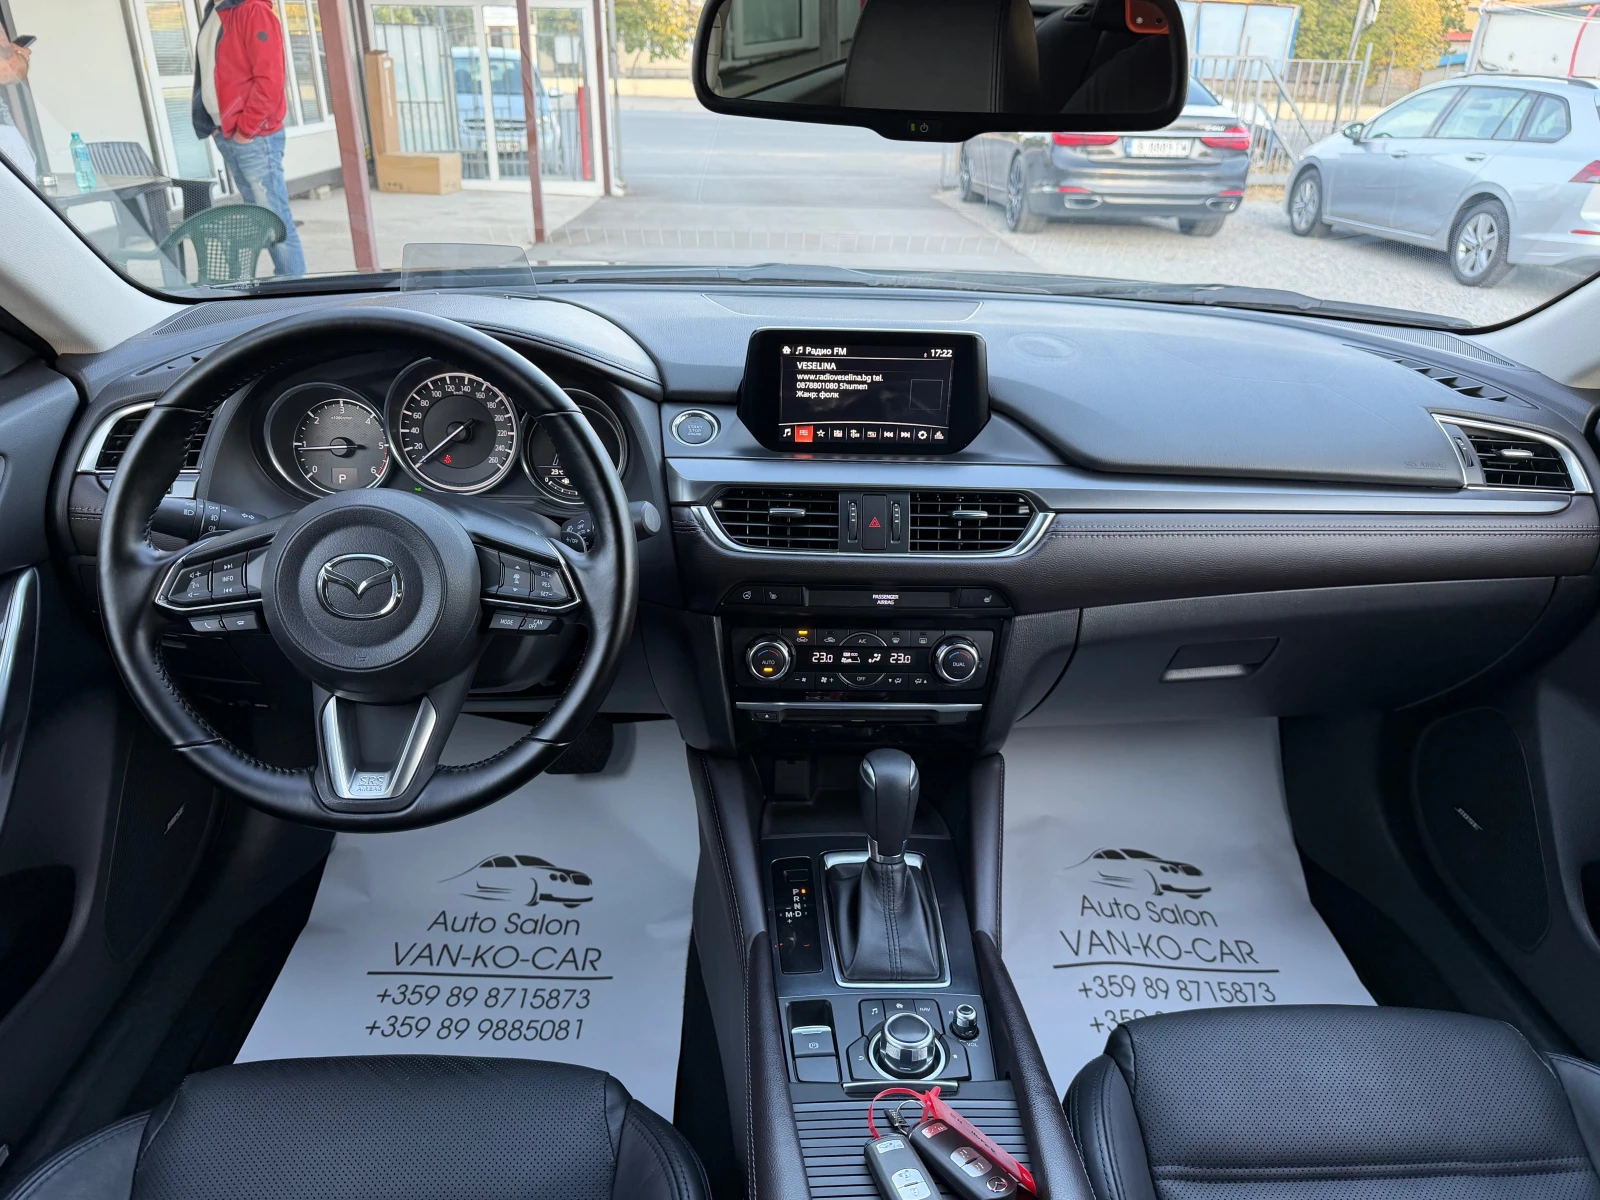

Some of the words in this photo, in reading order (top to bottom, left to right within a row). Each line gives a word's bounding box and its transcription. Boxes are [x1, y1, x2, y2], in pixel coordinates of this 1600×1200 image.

[806, 347, 832, 356] Радио
[833, 347, 847, 355] FM
[930, 349, 953, 358] 17:22
[796, 361, 837, 370] VESELINA
[796, 373, 872, 383] www.radioveselina.bg
[872, 374, 884, 382] tel.
[445, 384, 455, 392] 120
[839, 382, 868, 390] Shumen
[475, 391, 486, 399] 160
[796, 390, 819, 399] Жанр:
[819, 390, 840, 399] фолк
[420, 399, 429, 407] 80
[486, 401, 497, 409] 180
[339, 406, 345, 414] 3
[314, 416, 320, 425] 2
[497, 429, 508, 437] 220
[378, 442, 384, 450] 5
[413, 442, 423, 450] 20
[494, 444, 506, 452] 240
[488, 456, 499, 464] 260
[312, 465, 318, 473] 0
[370, 466, 377, 474] 6
[338, 474, 347, 484] P
[812, 652, 834, 663] 23.0
[889, 652, 911, 664] 23.0
[360, 775, 385, 785] SRS
[1080, 894, 1141, 921] Auto
[1145, 900, 1219, 928] Salon
[426, 910, 497, 934] Auto
[504, 912, 581, 936] Salon
[1059, 929, 1260, 965] VAN-KO-CAR
[394, 941, 602, 971] VAN-KO-CAR
[1078, 974, 1136, 999] +359
[1142, 976, 1170, 1000] 89
[1176, 978, 1276, 1003] 8715873
[376, 984, 441, 1006] +359
[446, 986, 479, 1008] 89
[484, 987, 591, 1010] 8715873
[365, 1015, 431, 1039] +359
[436, 1017, 471, 1041] 89
[477, 1018, 584, 1041] 9885081
